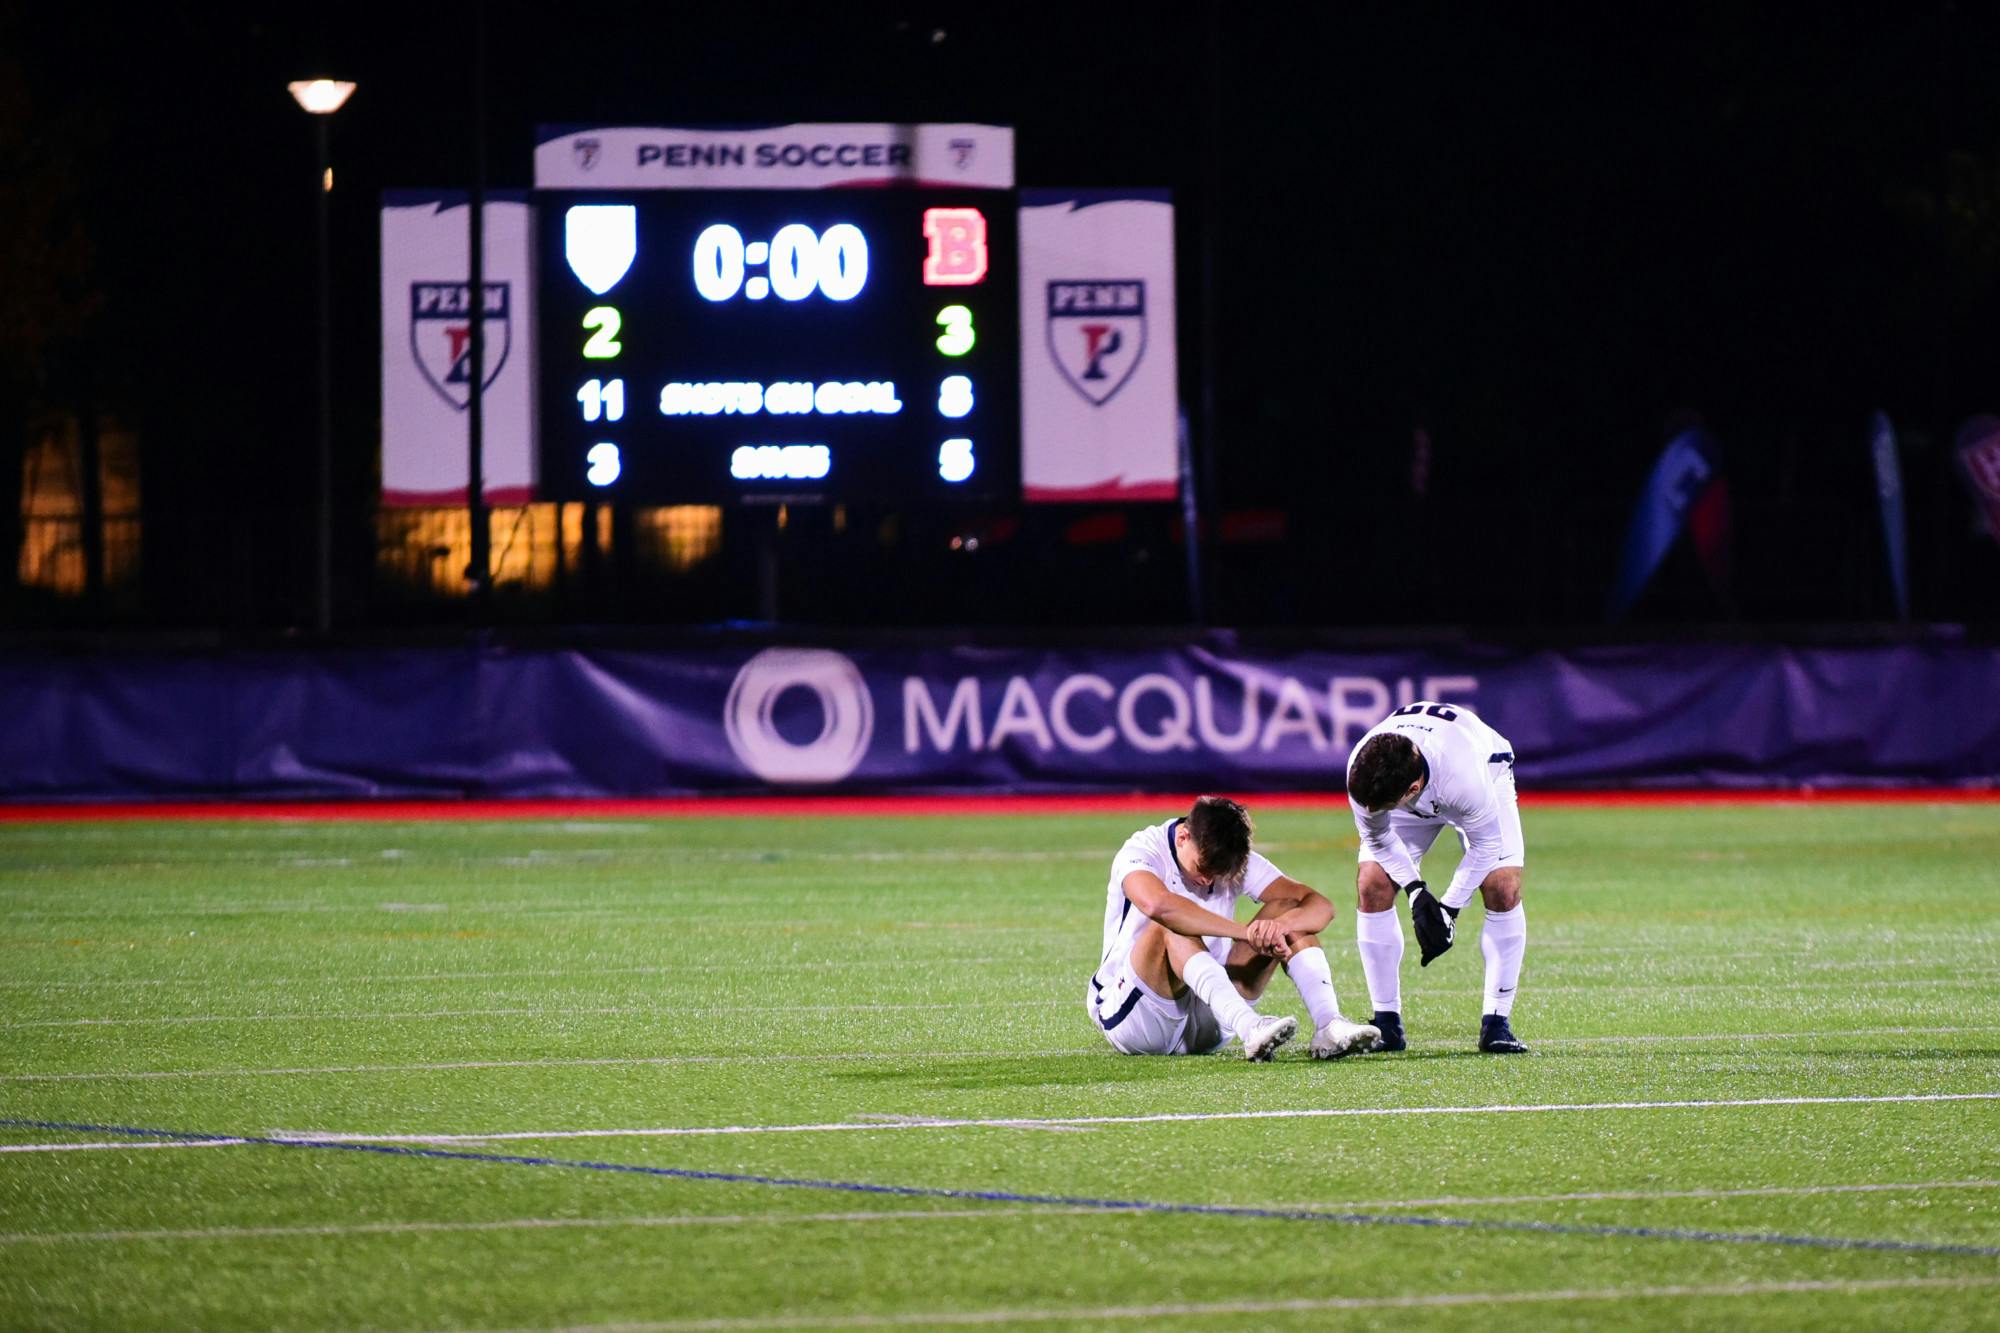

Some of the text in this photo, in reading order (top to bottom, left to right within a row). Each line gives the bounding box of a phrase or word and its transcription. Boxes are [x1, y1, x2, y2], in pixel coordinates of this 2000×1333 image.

[637, 143, 911, 167] PENN SOCCER
[693, 224, 869, 301] 0:00
[923, 208, 988, 286] B
[1054, 285, 1139, 307] PENN
[582, 306, 622, 358] 2
[936, 305, 975, 356] 3
[576, 379, 624, 421] 11
[587, 443, 621, 485] 3
